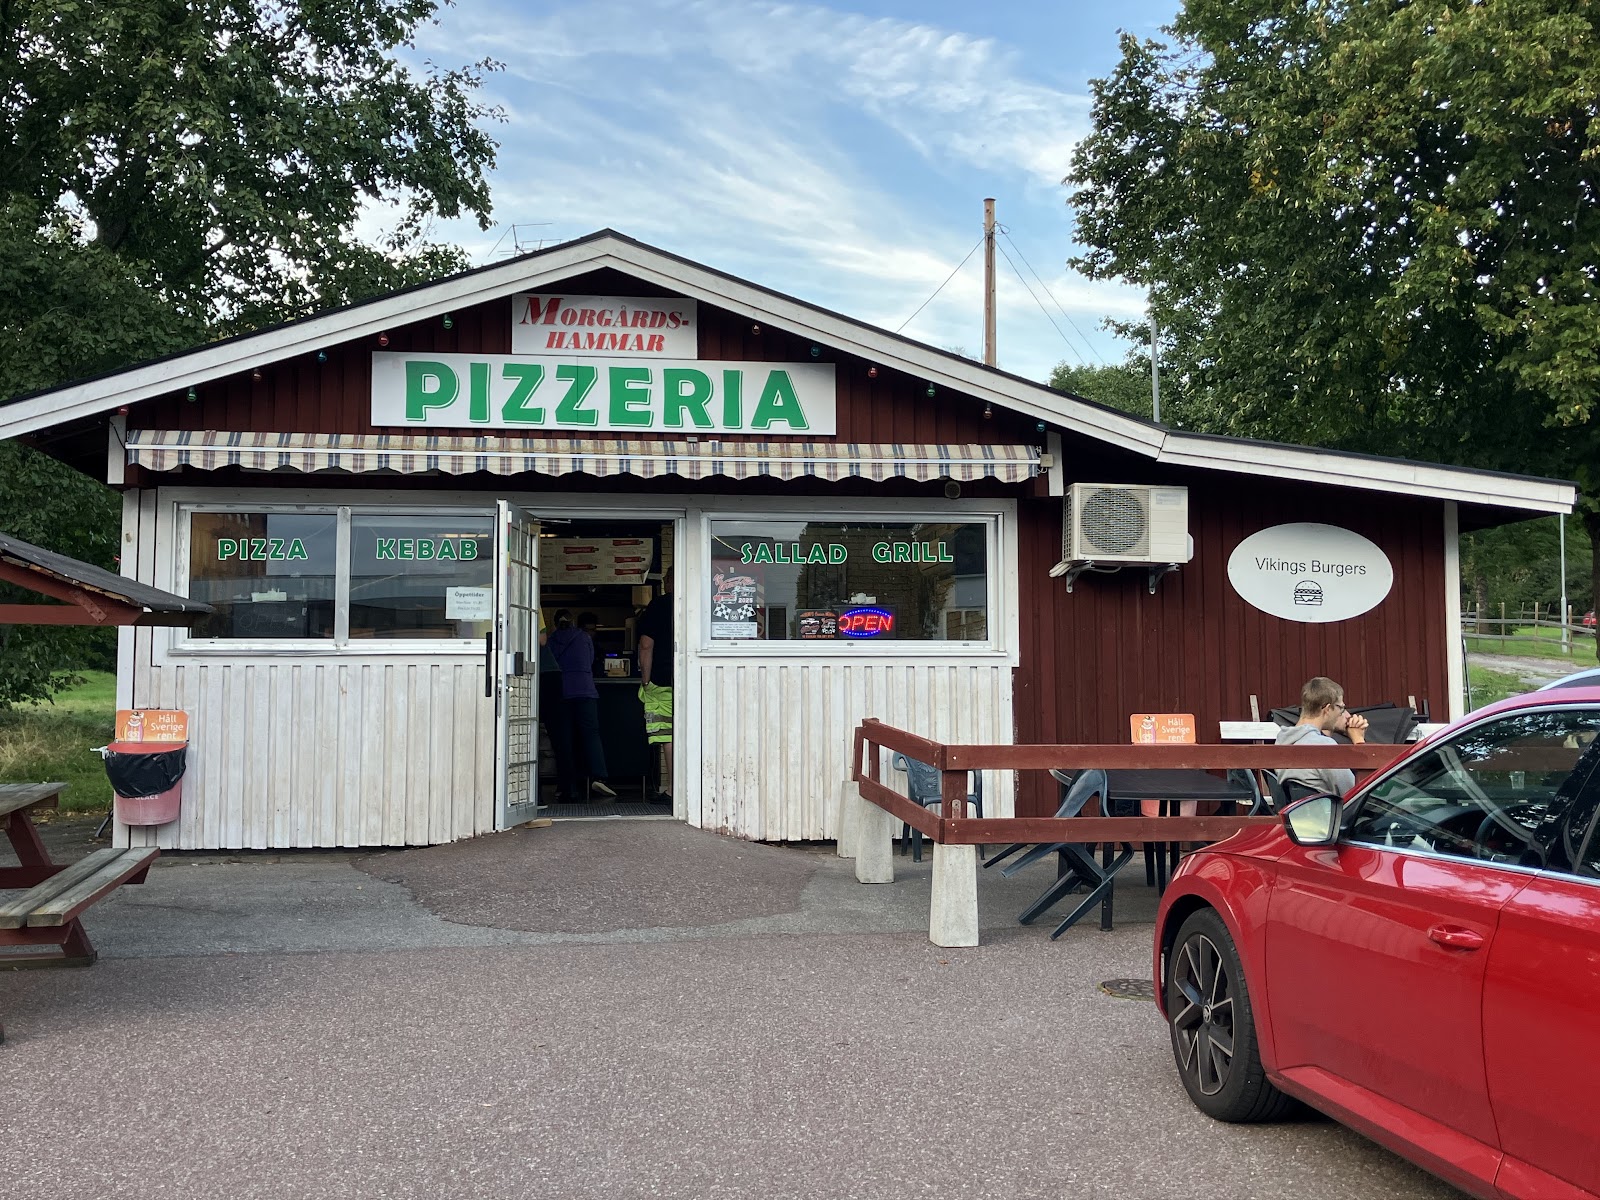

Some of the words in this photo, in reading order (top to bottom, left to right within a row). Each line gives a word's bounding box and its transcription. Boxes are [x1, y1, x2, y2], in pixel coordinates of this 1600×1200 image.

[519, 296, 690, 330] MORGÅRDS-
[545, 331, 665, 352] HAMMAR
[405, 361, 809, 429] PIZZERIA
[217, 538, 309, 561] PIZZA
[375, 537, 479, 561] KEBAB
[740, 542, 848, 564] SALLAD
[871, 541, 954, 563] GRILL
[1255, 556, 1307, 575] Vikings
[1311, 559, 1367, 577] Burgers
[838, 615, 892, 631] OPEN
[150, 723, 184, 732] Sverige
[158, 714, 177, 723] Håll
[1167, 717, 1184, 726] Håll
[156, 731, 177, 740] rent
[1161, 726, 1190, 735] Sverige
[1168, 734, 1185, 742] rent
